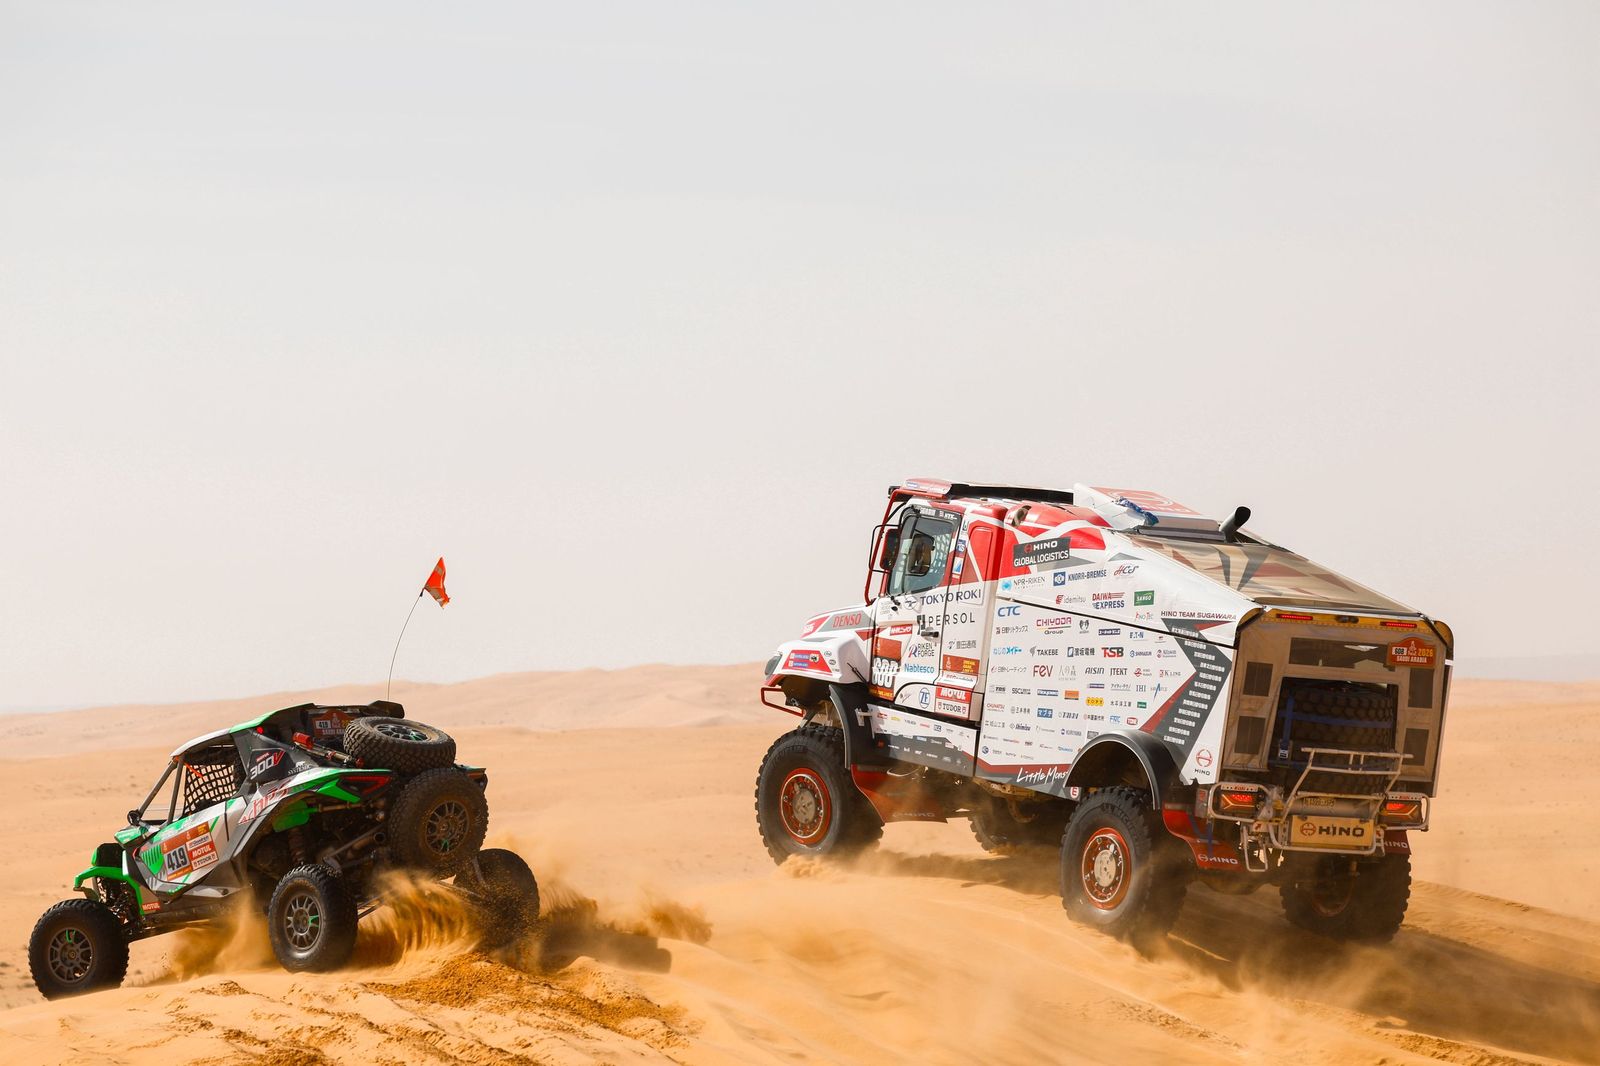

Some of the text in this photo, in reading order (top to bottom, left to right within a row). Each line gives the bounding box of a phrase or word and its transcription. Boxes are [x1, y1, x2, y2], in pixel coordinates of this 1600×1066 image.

[1033, 541, 1058, 551] HINO
[1014, 550, 1069, 567] GLOBAL LOGISTICS
[1013, 576, 1046, 586] NPR-RIKEN
[1067, 569, 1107, 582] KNORR-BREMSE
[920, 588, 981, 606] TOKYO ROKI
[1092, 592, 1113, 601] DAIWA
[1095, 600, 1125, 609] EXPRESS
[997, 605, 1022, 617] CTC
[1196, 612, 1237, 620] SUGAWARA
[832, 613, 863, 628] DENSO
[928, 612, 976, 627] PERSOL
[1036, 616, 1072, 627] CHIYODA
[918, 649, 935, 657] FORGE
[1036, 648, 1059, 656] TAKEBE
[1101, 646, 1125, 658] TSB
[1418, 648, 1433, 657] 2026
[904, 662, 935, 674] Nabtesco
[1084, 667, 1105, 675] AISIN
[1109, 667, 1128, 676] JTEKT
[1135, 684, 1146, 692] IHI
[940, 687, 966, 701] MOTUL
[942, 702, 962, 713] TUDOR
[250, 750, 286, 780] 300V
[1194, 767, 1211, 776] HINO
[1318, 825, 1365, 837] HINO
[192, 844, 212, 859] MOTUL
[166, 847, 188, 871] 419
[1208, 856, 1239, 865] HINO
